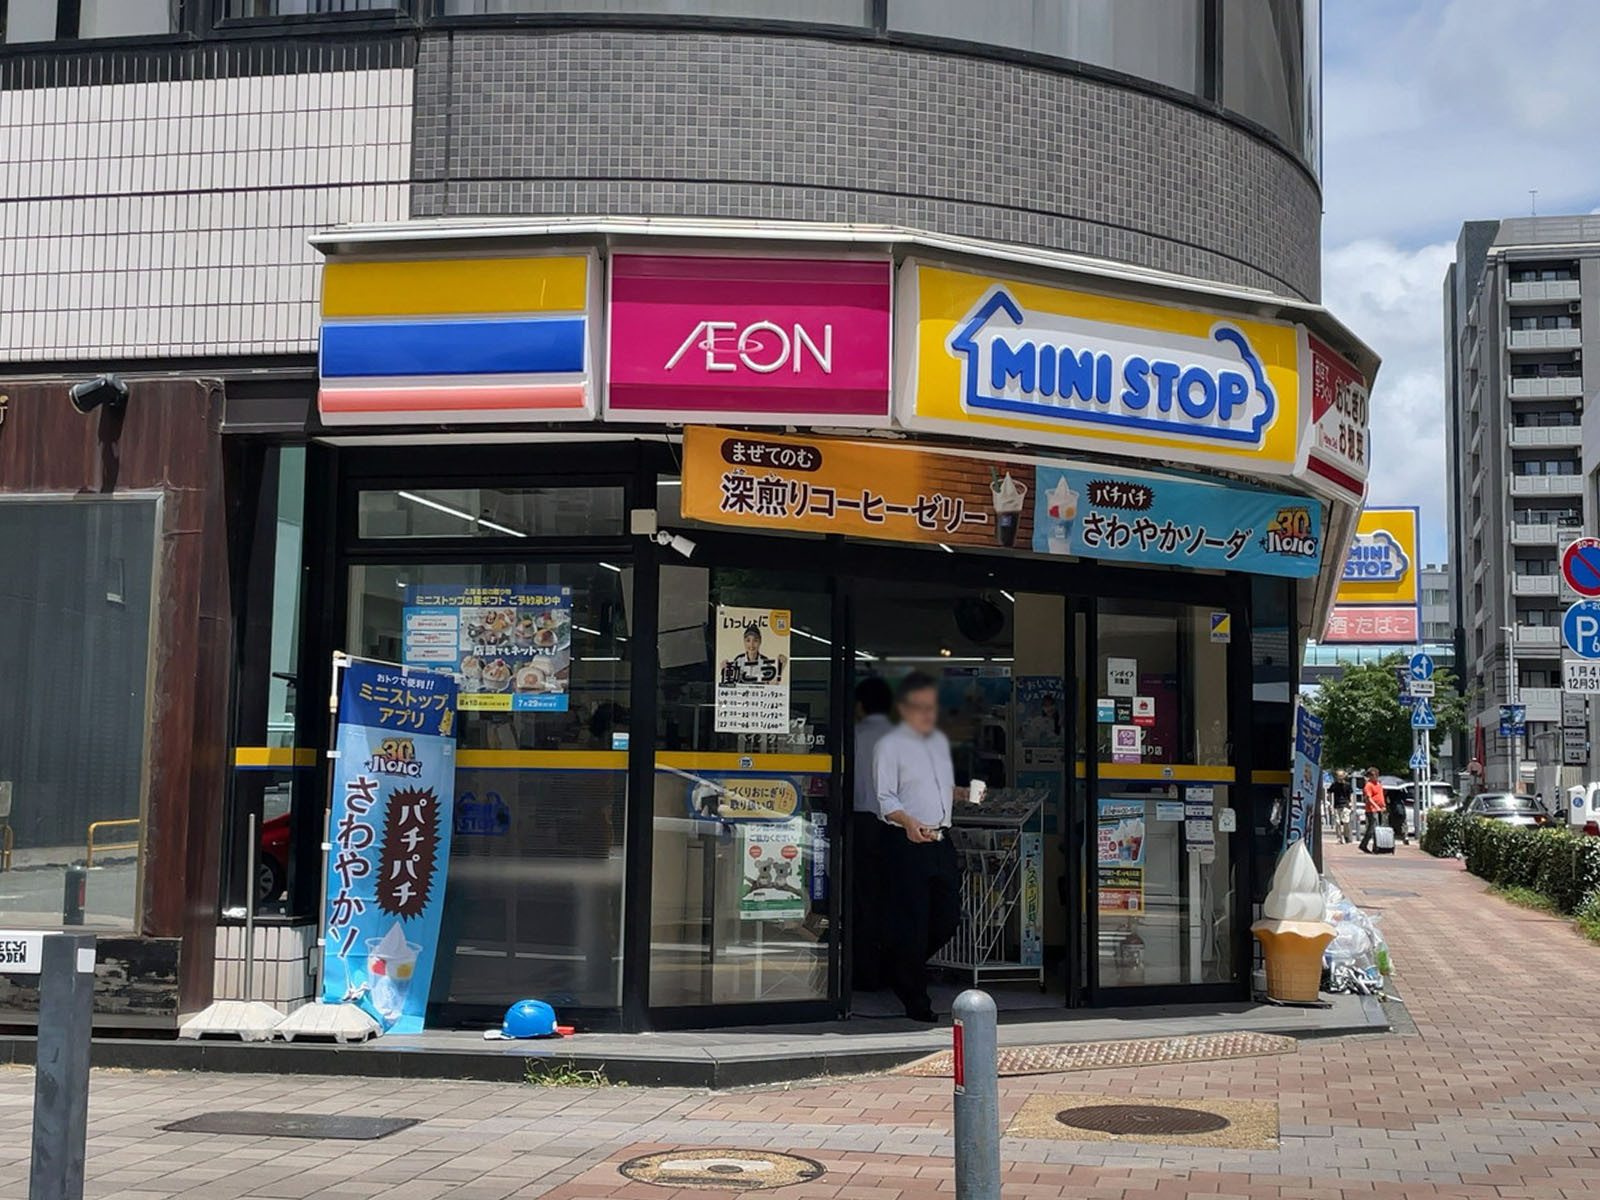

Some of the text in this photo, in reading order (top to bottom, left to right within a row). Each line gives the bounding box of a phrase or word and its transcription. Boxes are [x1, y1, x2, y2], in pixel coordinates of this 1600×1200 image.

[990, 334, 1250, 421] MINI STOP
[732, 441, 814, 468] まぜてのむ
[720, 472, 988, 534] 深煎りコーヒーゼリー
[1096, 487, 1148, 507] パチパチ
[1083, 510, 1254, 560] さわやかソーダ
[1277, 510, 1311, 538] 30
[1348, 546, 1390, 560] MINI
[1344, 561, 1393, 576] STOP
[1576, 616, 1599, 653] P
[376, 673, 435, 690] おトクで便利!!
[1569, 665, 1600, 678] 1月4
[359, 682, 449, 711] ミニストップ
[379, 707, 425, 729] アプリ
[382, 740, 415, 762] 30
[389, 798, 427, 908] パチパチ
